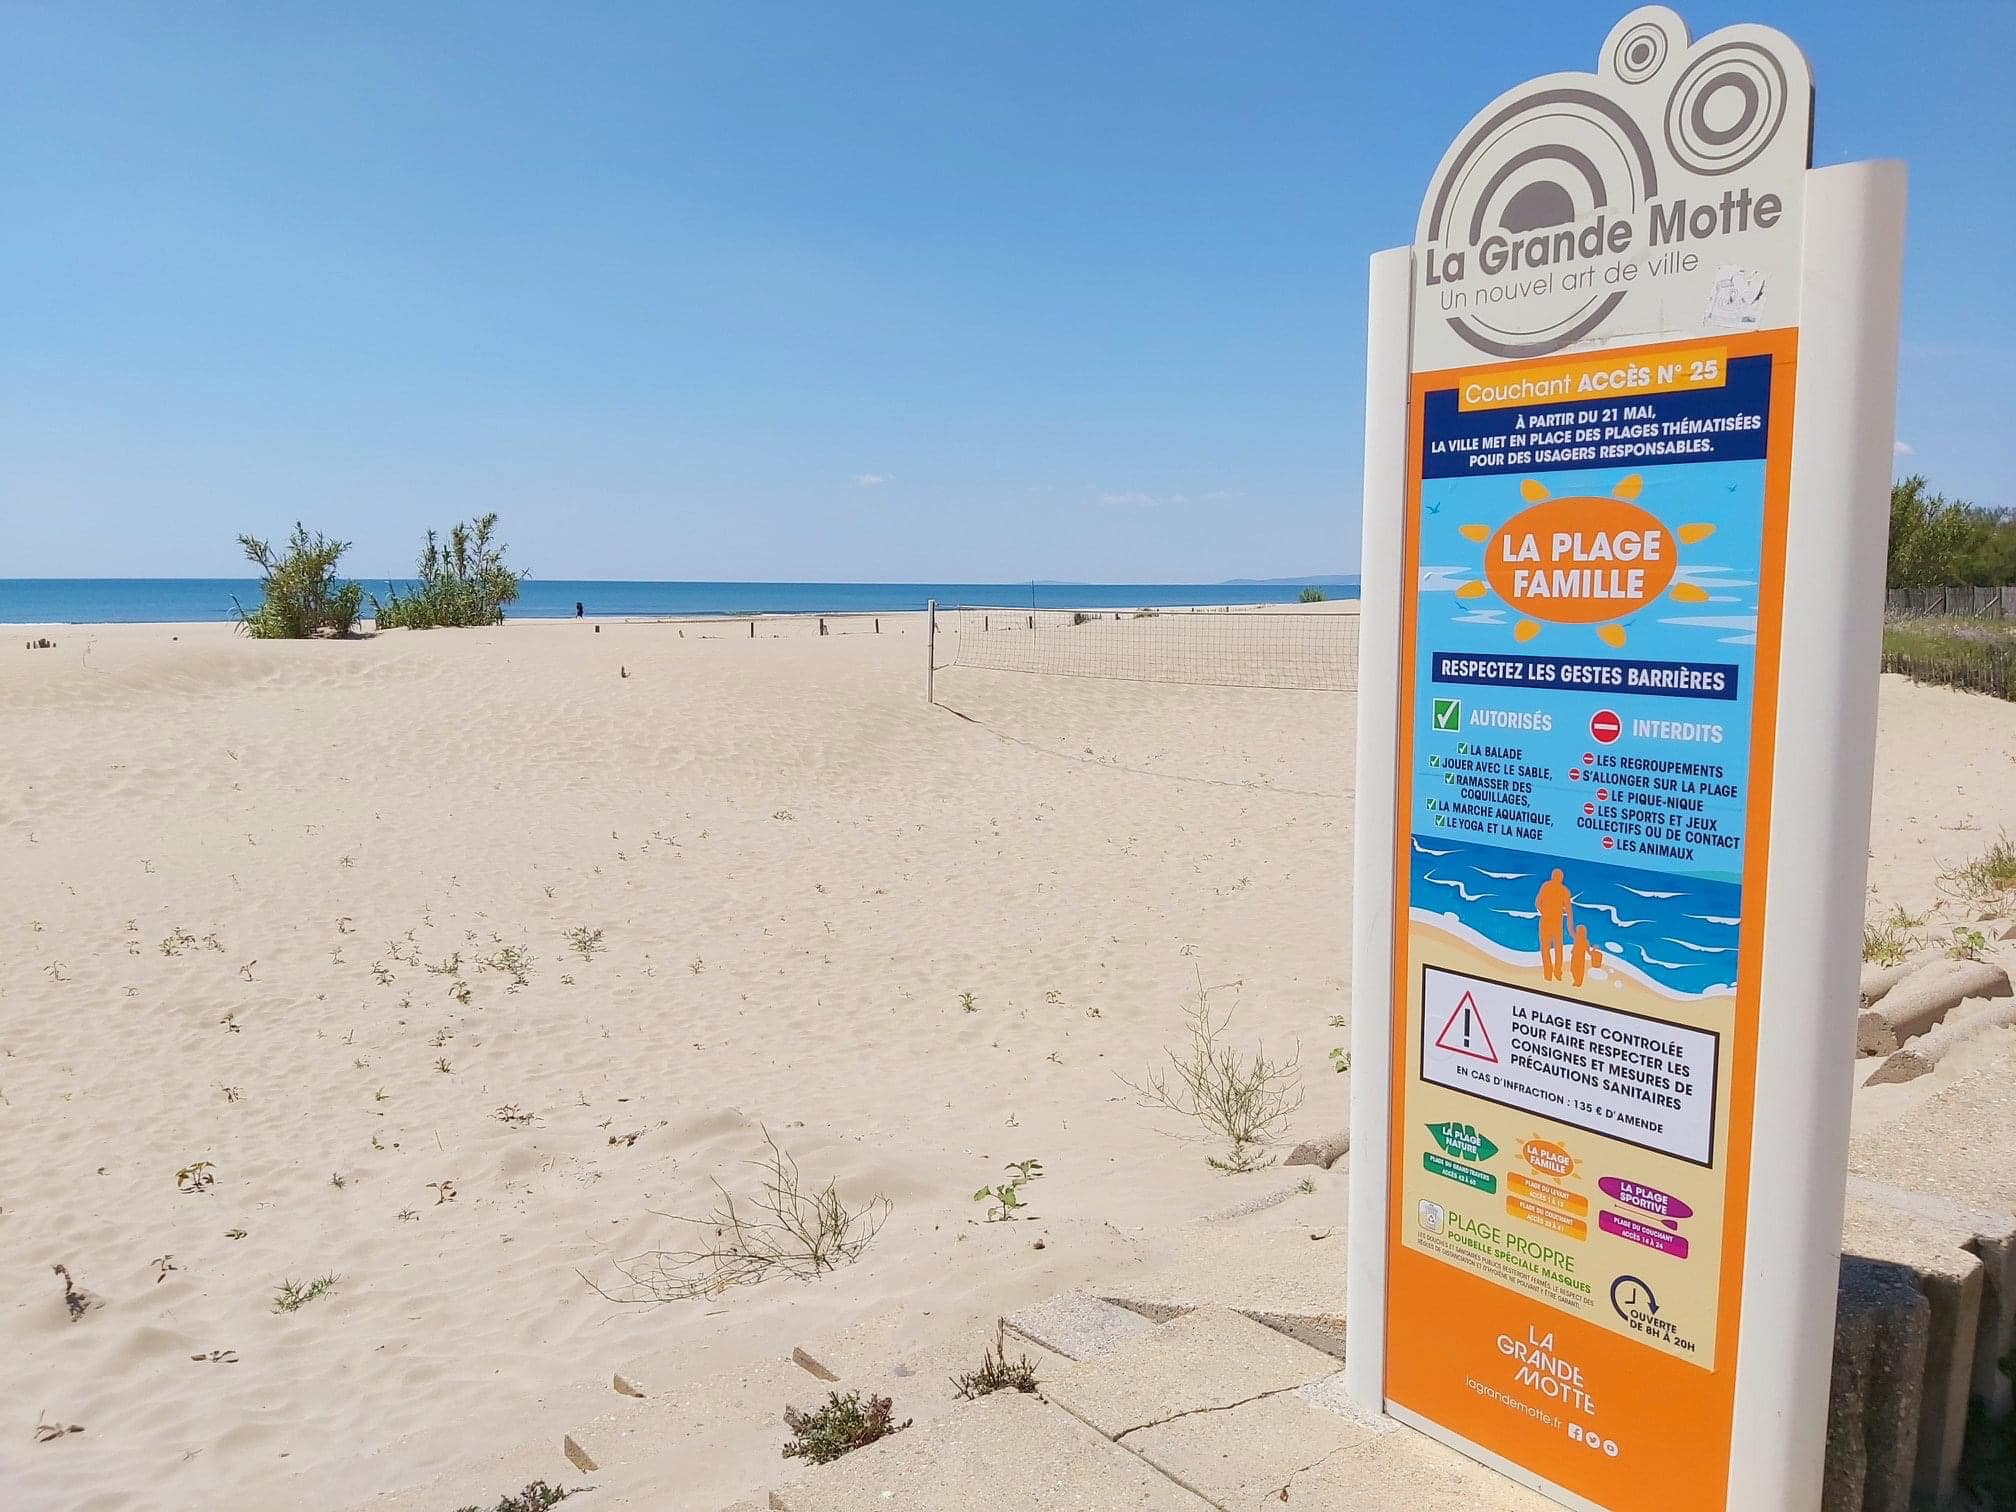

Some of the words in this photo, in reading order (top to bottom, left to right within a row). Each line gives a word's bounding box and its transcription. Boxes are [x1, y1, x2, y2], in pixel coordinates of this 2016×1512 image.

[1426, 249, 1465, 286] La
[1479, 214, 1632, 275] Grande
[1649, 188, 1782, 247] Motte
[1441, 290, 1466, 310] Un
[1476, 273, 1552, 305] nouvel
[1562, 266, 1595, 290] art
[1604, 261, 1637, 283] de
[1648, 251, 1698, 276] ville
[1466, 374, 1572, 403] Couchant
[1577, 363, 1650, 392] ACCÈS
[1658, 364, 1682, 384] N°
[1690, 360, 1718, 381] 25
[1515, 414, 1525, 430] À
[1529, 413, 1574, 428] PARTIR
[1578, 409, 1598, 424] DU
[1602, 409, 1617, 422] 21
[1623, 405, 1656, 420] MAI,
[1432, 440, 1446, 453] LA
[1448, 438, 1479, 451] VILLE
[1482, 436, 1506, 449] MET
[1509, 434, 1525, 447] EN
[1530, 431, 1572, 445] PLACE
[1576, 428, 1601, 442] DES
[1605, 424, 1659, 440] PLAGES
[1662, 413, 1761, 436] THÉMATISÉES
[1470, 454, 1504, 467] POUR
[1508, 452, 1531, 465] DES
[1535, 447, 1596, 463] USAGERS
[1600, 438, 1714, 458] RESPONSABLES.
[1503, 533, 1541, 562] LA
[1552, 530, 1661, 562] PLAGE
[1514, 569, 1644, 599] FAMILLE
[1442, 660, 1523, 680] RESPECTEZ
[1528, 664, 1556, 681] LES
[1560, 665, 1622, 684] GESTES
[1628, 666, 1725, 691] BARRIÈRES
[1470, 709, 1552, 731] AUTORISÉS
[1632, 719, 1723, 744] INTERDITS
[1471, 745, 1481, 756] LA
[1485, 746, 1522, 760] BALADE
[1442, 758, 1473, 770] JOUER
[1475, 762, 1500, 773] AVEC
[1504, 764, 1514, 775] LE
[1518, 765, 1552, 781] SABLE,
[1597, 755, 1616, 767] LES
[1621, 757, 1723, 778] REGROUPEMENTS
[1457, 775, 1509, 790] RAMASSER
[1513, 782, 1532, 793] DES
[1654, 778, 1677, 791] SUR
[1681, 781, 1695, 793] LA
[1700, 783, 1738, 798] PLAGE
[1461, 788, 1530, 808] COQUILLAGES,
[1612, 790, 1623, 802] LE
[1628, 792, 1703, 811] PIQUE-NIQUE
[1439, 801, 1449, 812] LA
[1453, 803, 1493, 817] MARCHE
[1496, 809, 1554, 827] AQUATIQUE,
[1598, 806, 1617, 818] LES
[1621, 809, 1665, 824] SPORTS
[1670, 815, 1682, 826] ET
[1686, 817, 1717, 831] JEUX
[1447, 817, 1456, 827] LE
[1459, 819, 1484, 832] YOGA
[1488, 823, 1498, 833] ET
[1501, 825, 1512, 836] LA
[1516, 827, 1543, 840] NAGE
[1577, 817, 1641, 835] COLLECTIFS
[1645, 826, 1662, 838] OU
[1666, 829, 1681, 841] DE
[1686, 831, 1740, 849] CONTACT
[1617, 839, 1636, 851] LES
[1639, 842, 1694, 860] ANIMAUX
[1513, 1006, 1527, 1019] LA
[1532, 1010, 1572, 1030] PLAGE
[1576, 1022, 1596, 1036] EST
[1600, 1028, 1683, 1058] CONTROLÉE
[1512, 1022, 1546, 1040] POUR
[1551, 1032, 1585, 1050] FAIRE
[1589, 1042, 1663, 1070] RESPECTER
[1668, 1062, 1690, 1078] LES
[1512, 1038, 1587, 1068] CONSIGNES
[1592, 1060, 1604, 1072] ET
[1609, 1064, 1670, 1090] MESURES
[1675, 1082, 1693, 1096] DE
[1457, 1066, 1468, 1076] EN
[1471, 1070, 1490, 1083] CAS
[1574, 1100, 1592, 1112] 135
[1596, 1106, 1602, 1116] €
[1511, 1054, 1599, 1088] PRÉCAUTIONS
[1603, 1079, 1682, 1110] SANITAIRES
[1442, 1127, 1452, 1136] LA
[1455, 1131, 1481, 1146] PLAGE
[1446, 1137, 1477, 1153] NATURE
[1527, 1145, 1537, 1155] LA
[1541, 1150, 1569, 1165] PLAGE
[1531, 1156, 1566, 1174] FAMILLE
[1620, 1192, 1668, 1214] SPORTIVE
[1621, 1182, 1632, 1193] LA
[1636, 1186, 1668, 1205] PLAGE
[1449, 1211, 1500, 1243] PLAGE
[1507, 1233, 1574, 1272] PROPRE
[1614, 1217, 1631, 1227] PLAGE
[1632, 1223, 1640, 1231] DU
[1642, 1227, 1673, 1242] COUCHANT
[1448, 1231, 1492, 1255] POUBELLE
[1494, 1248, 1539, 1274] SPÉCIALE
[1542, 1268, 1591, 1293] MASQUES
[1631, 1310, 1677, 1334] OUVERTE
[1529, 1324, 1553, 1352] LA
[1630, 1320, 1643, 1331] DE
[1646, 1326, 1659, 1338] 8H
[1663, 1331, 1670, 1343] À
[1674, 1337, 1695, 1352] 20H
[1497, 1335, 1584, 1388] GRANDE
[1466, 1376, 1562, 1429] lagrandemotte.fr
[1514, 1367, 1595, 1415] MOTTE
